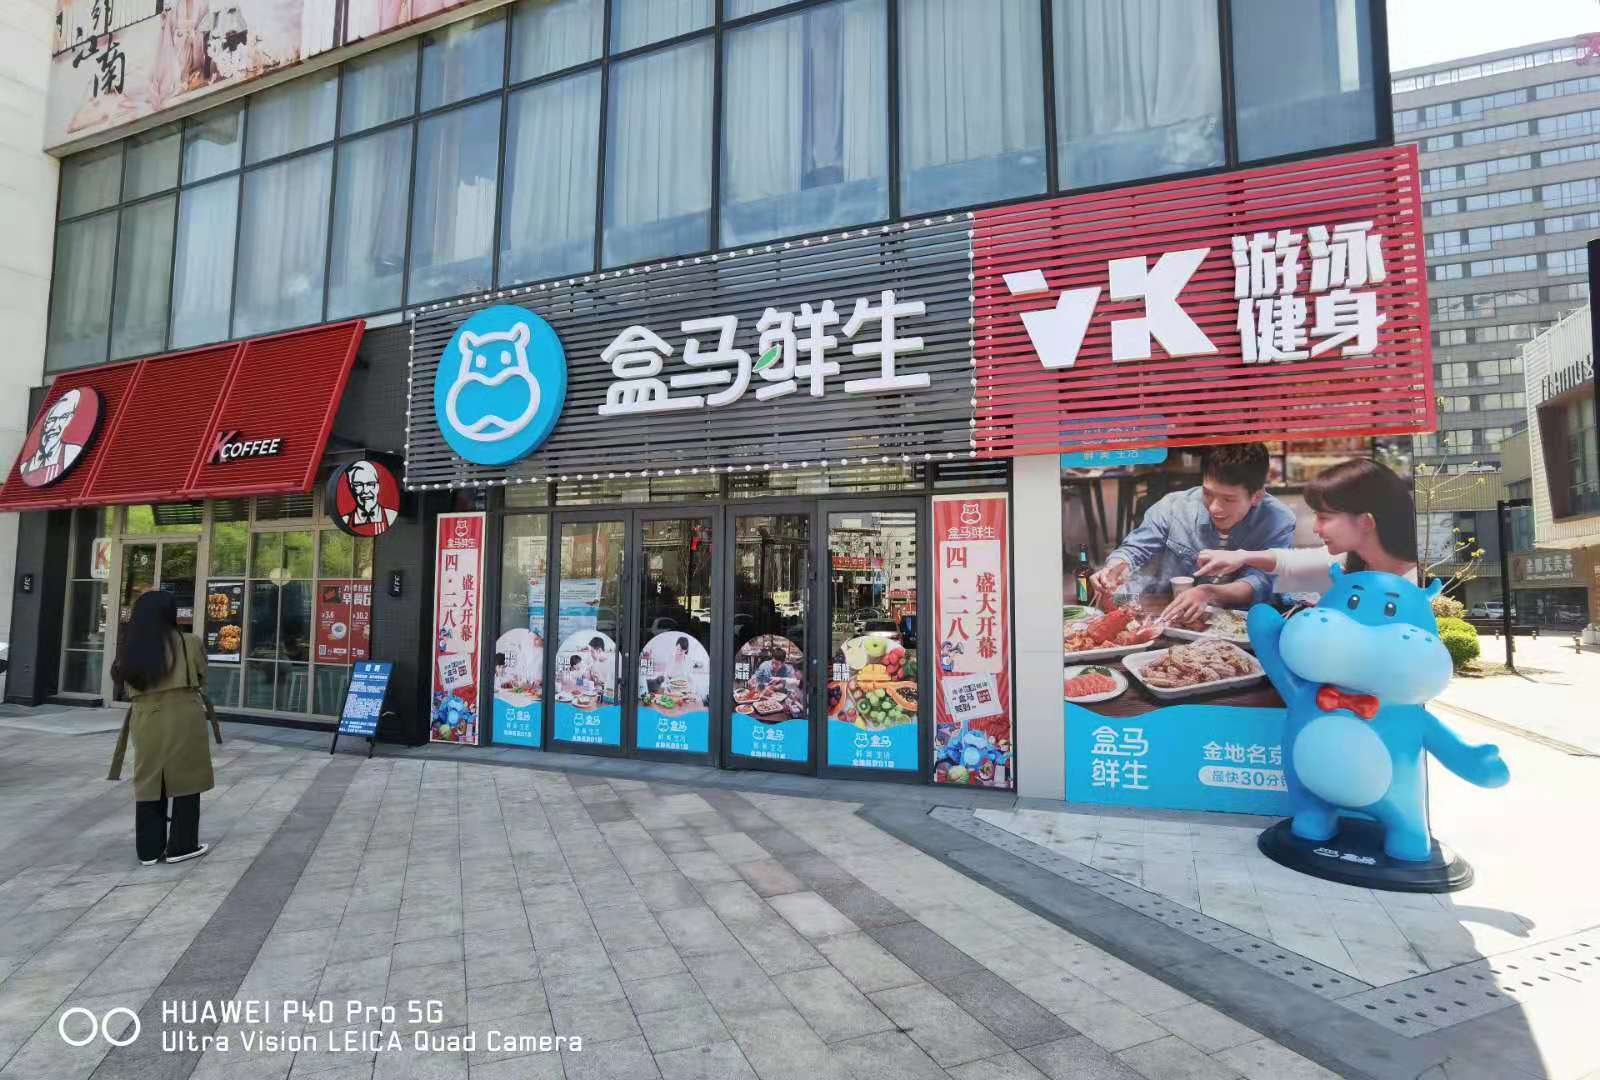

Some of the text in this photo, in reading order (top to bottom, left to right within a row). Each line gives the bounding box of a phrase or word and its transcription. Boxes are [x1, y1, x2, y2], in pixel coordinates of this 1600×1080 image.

[1231, 220, 1387, 300] 游泳
[597, 289, 931, 417] 盒马鲜生
[1235, 289, 1387, 364] 健身
[945, 527, 995, 540] 盒马鲜生
[460, 574, 474, 642] 盛大开幕
[976, 571, 997, 659] 盛大开幕
[1091, 725, 1150, 757] 盒马
[1091, 758, 1151, 790] 鲜生
